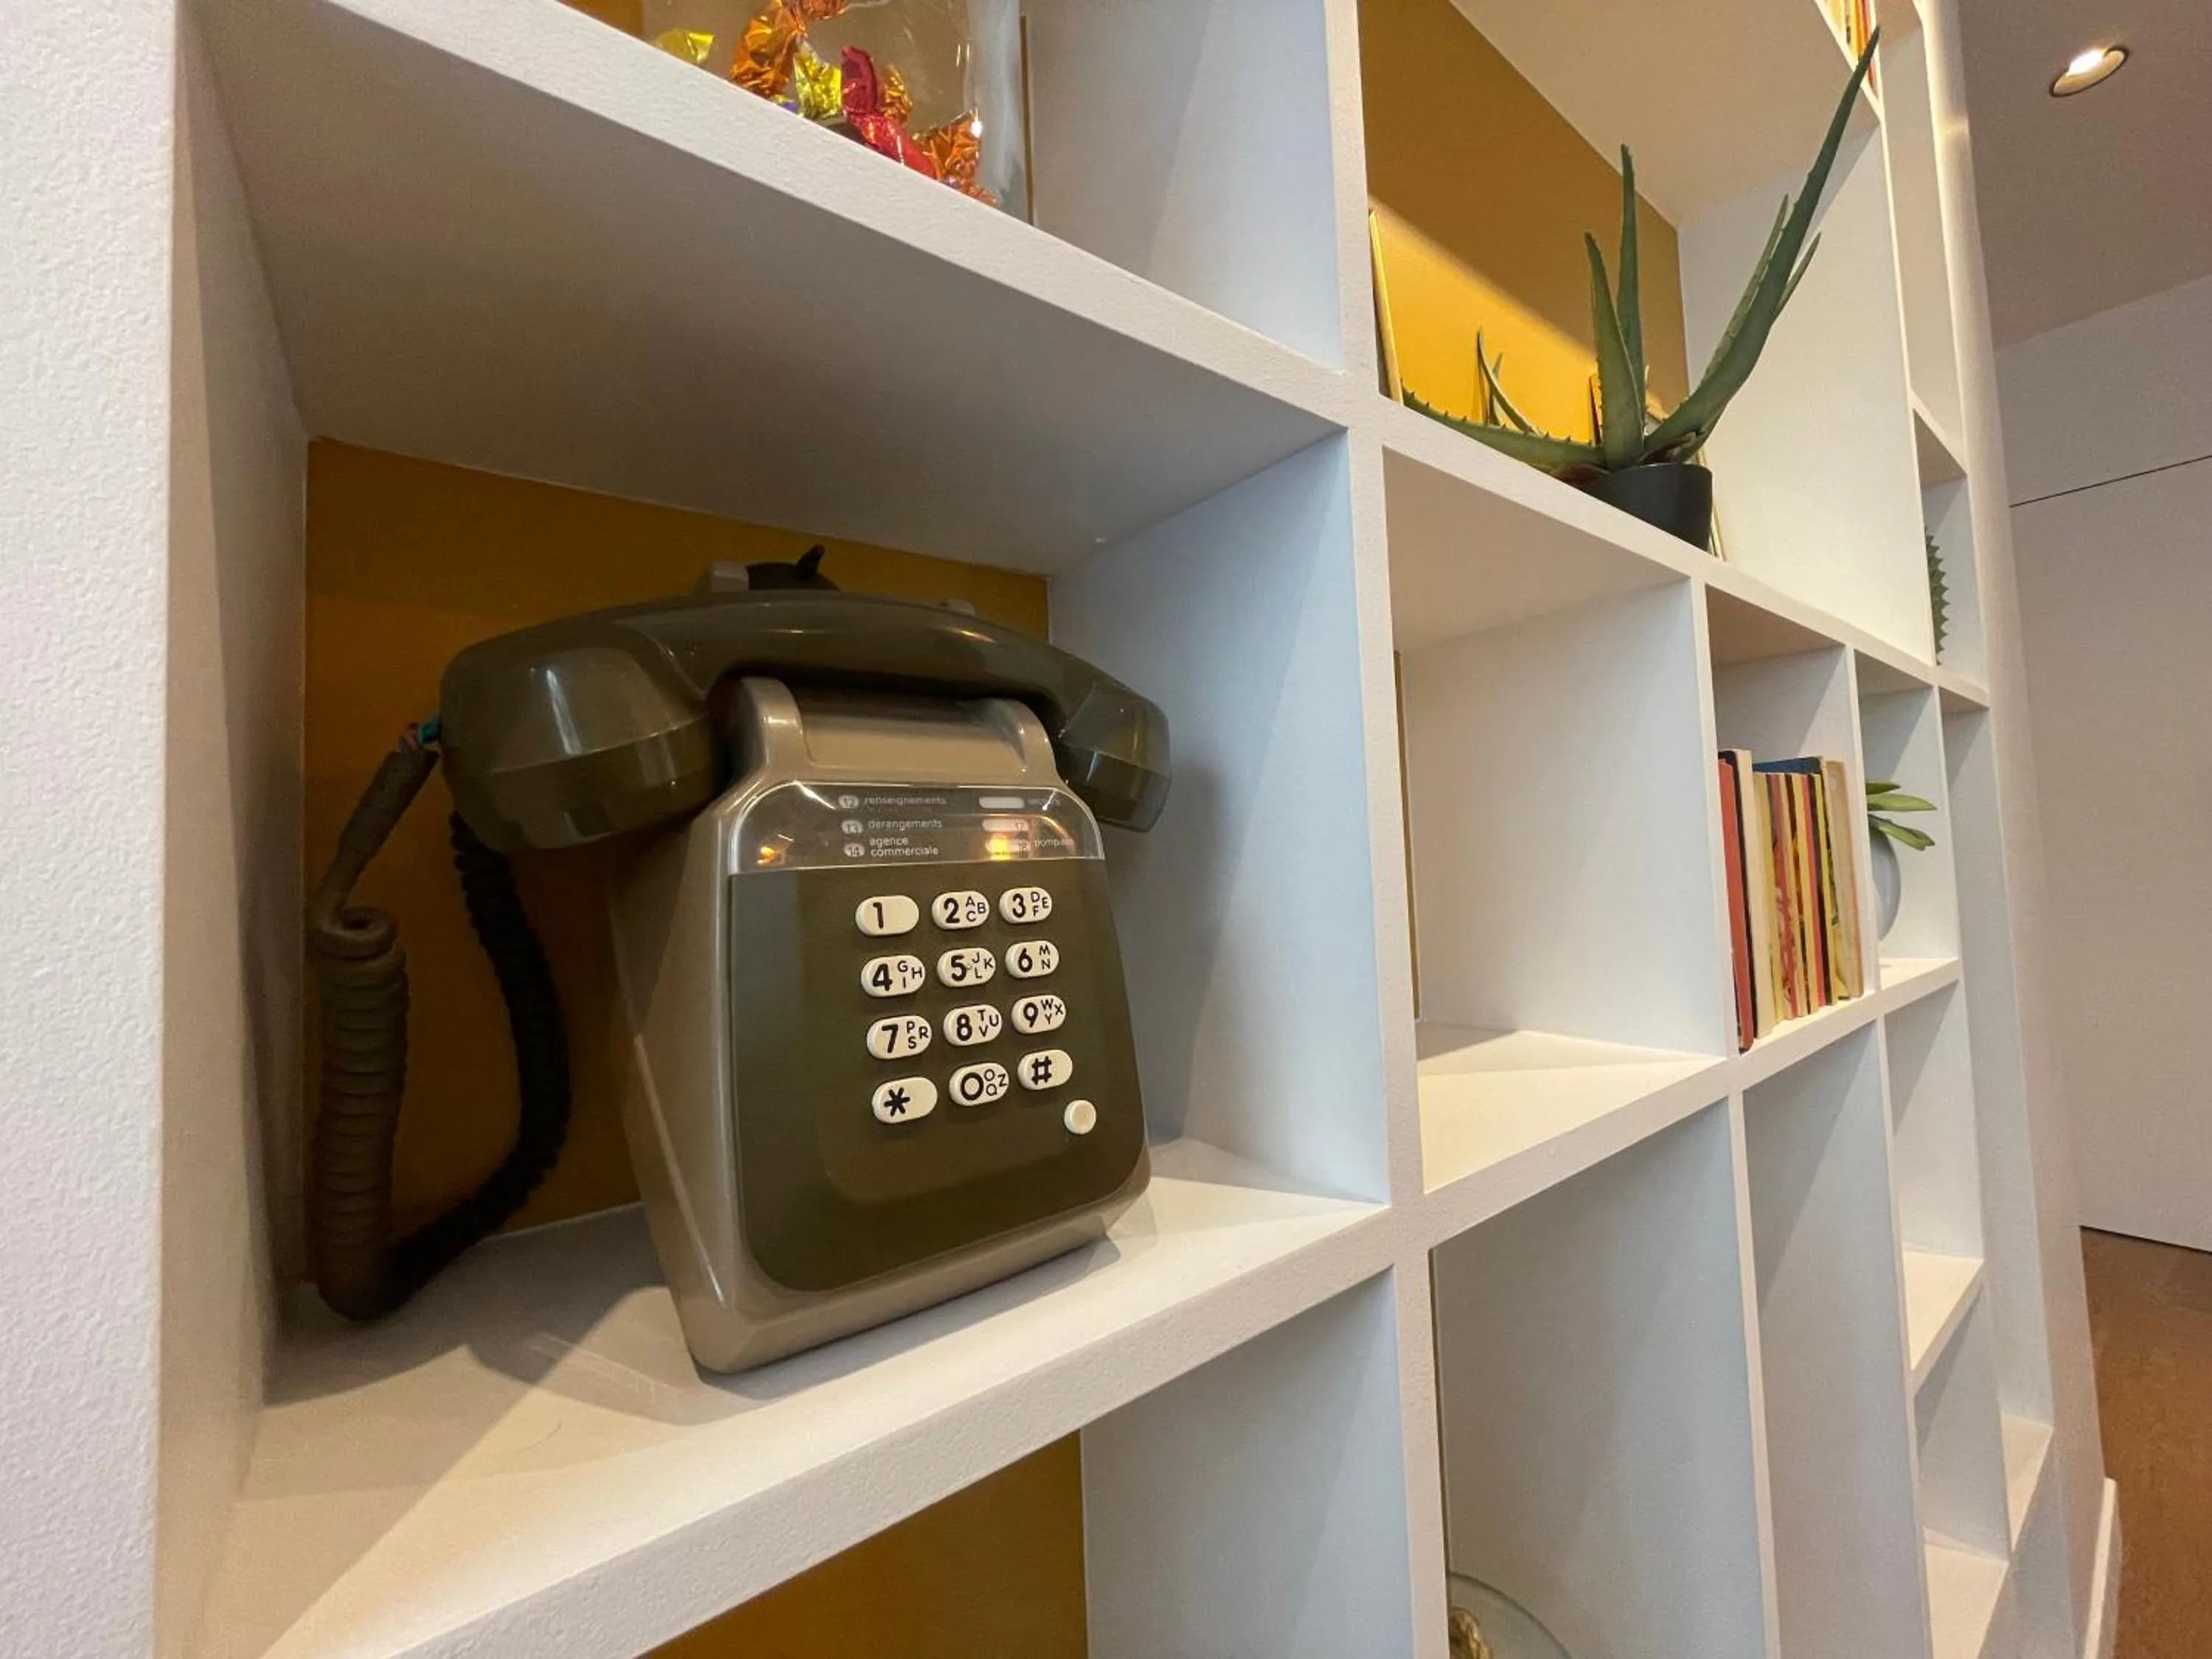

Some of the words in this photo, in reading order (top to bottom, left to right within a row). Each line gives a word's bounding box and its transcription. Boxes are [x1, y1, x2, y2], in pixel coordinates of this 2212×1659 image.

[863, 795, 947, 806] renseignements
[869, 837, 909, 848] agence
[870, 845, 939, 858] commerciale
[872, 901, 884, 929] 1
[943, 897, 960, 924] 2
[1012, 893, 1026, 919] 3
[950, 955, 967, 981] 5
[1018, 947, 1033, 973] 6
[872, 963, 894, 992] 4
[956, 1013, 973, 1042] 8
[1023, 1001, 1039, 1028] 9
[881, 1023, 900, 1054] 7
